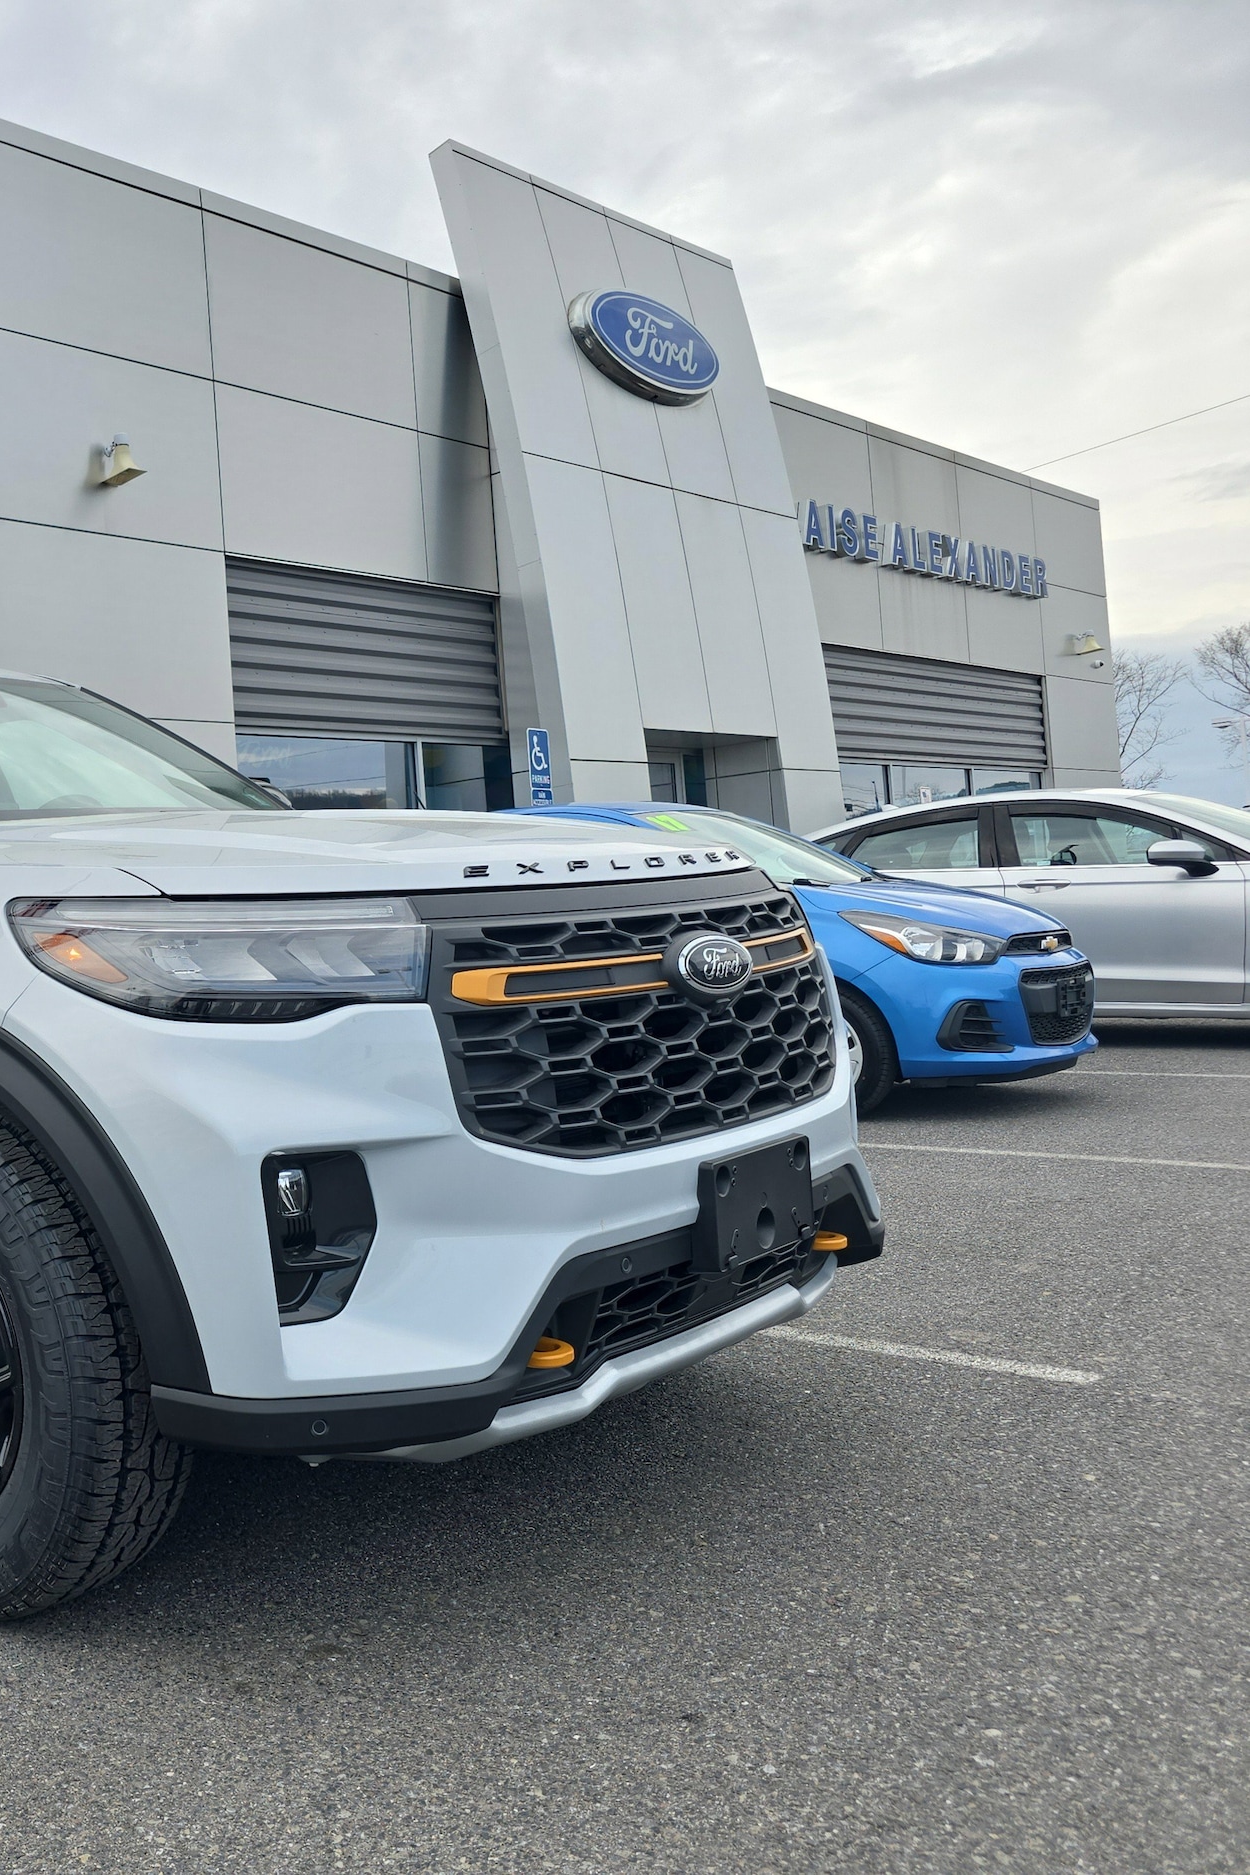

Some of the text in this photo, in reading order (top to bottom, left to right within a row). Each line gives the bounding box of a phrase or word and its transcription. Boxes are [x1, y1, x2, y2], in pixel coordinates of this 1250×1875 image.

[625, 307, 698, 375] Ford
[802, 498, 1049, 598] AISE ALEXANDER
[463, 850, 740, 878] EXPLORER
[703, 948, 742, 980] Ford
